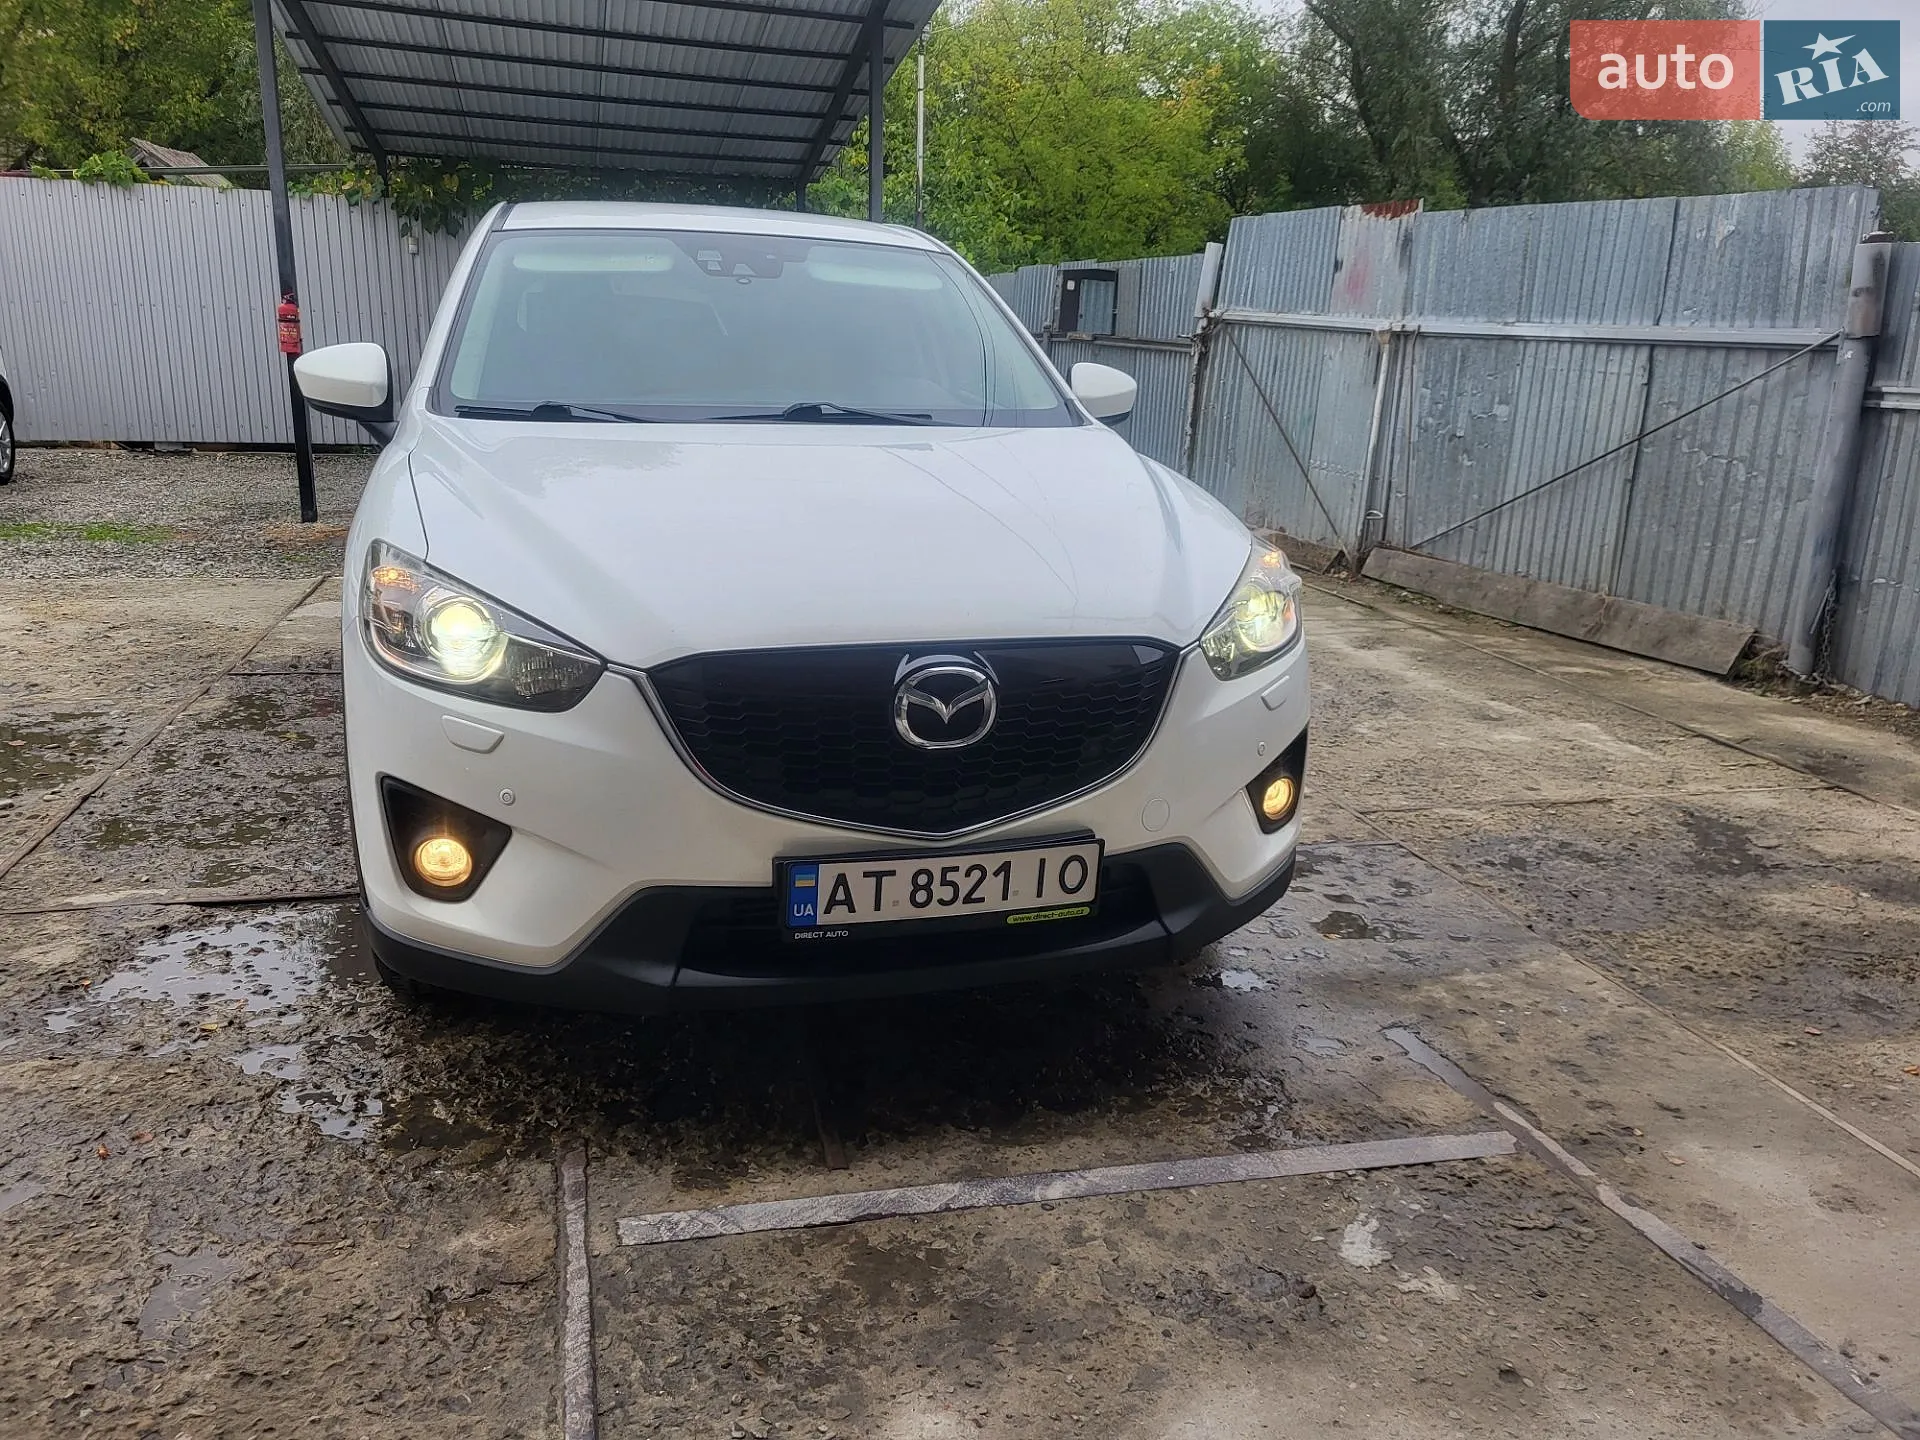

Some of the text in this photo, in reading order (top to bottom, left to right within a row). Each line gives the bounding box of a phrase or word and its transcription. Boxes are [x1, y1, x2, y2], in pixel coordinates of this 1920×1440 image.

[823, 855, 1088, 914] AT 8521 IO
[793, 903, 814, 918] UA
[1012, 909, 1085, 922] www.direct-auto.cz
[794, 930, 849, 940] DIRECT AUTO
